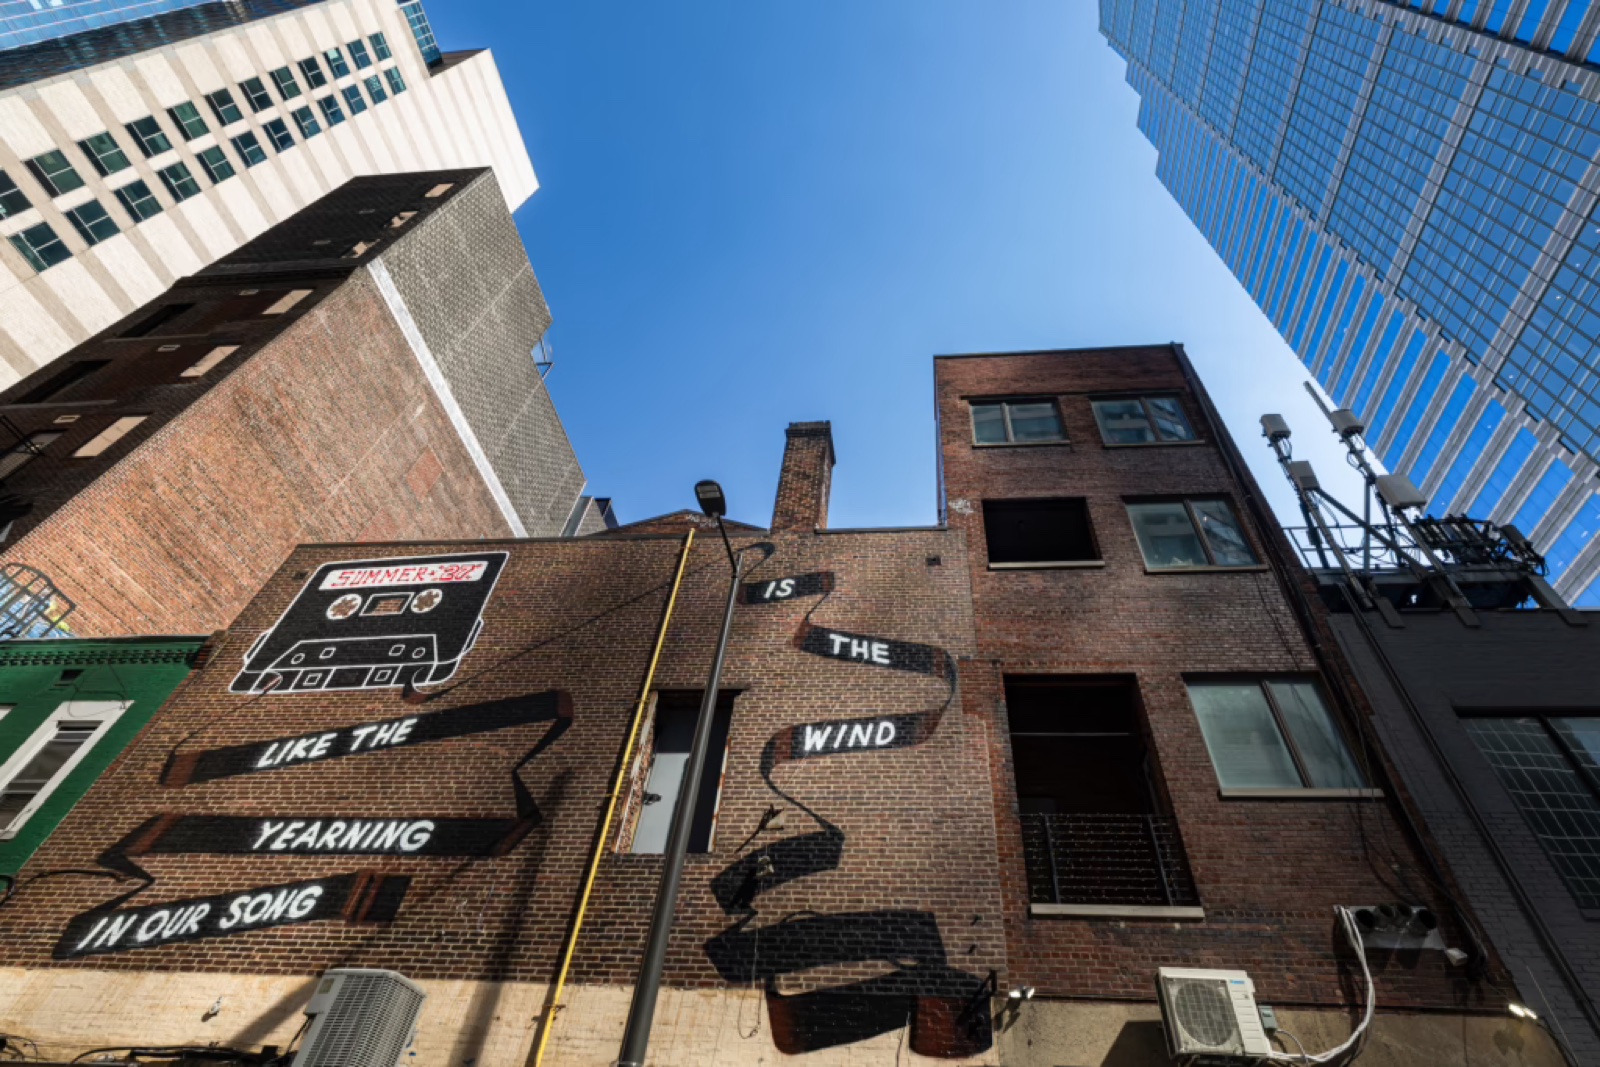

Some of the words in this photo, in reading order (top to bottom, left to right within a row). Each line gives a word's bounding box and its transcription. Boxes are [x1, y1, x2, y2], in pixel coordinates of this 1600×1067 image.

[331, 566, 429, 586] SUMMER
[763, 578, 796, 599] IS
[829, 633, 891, 665] THE
[254, 735, 338, 768] LIKE
[350, 718, 418, 752] THE
[803, 721, 896, 752] WIND
[252, 819, 436, 851] YEARNING
[76, 913, 138, 951] IN
[135, 902, 211, 943] OUR
[219, 885, 324, 930] SONG
